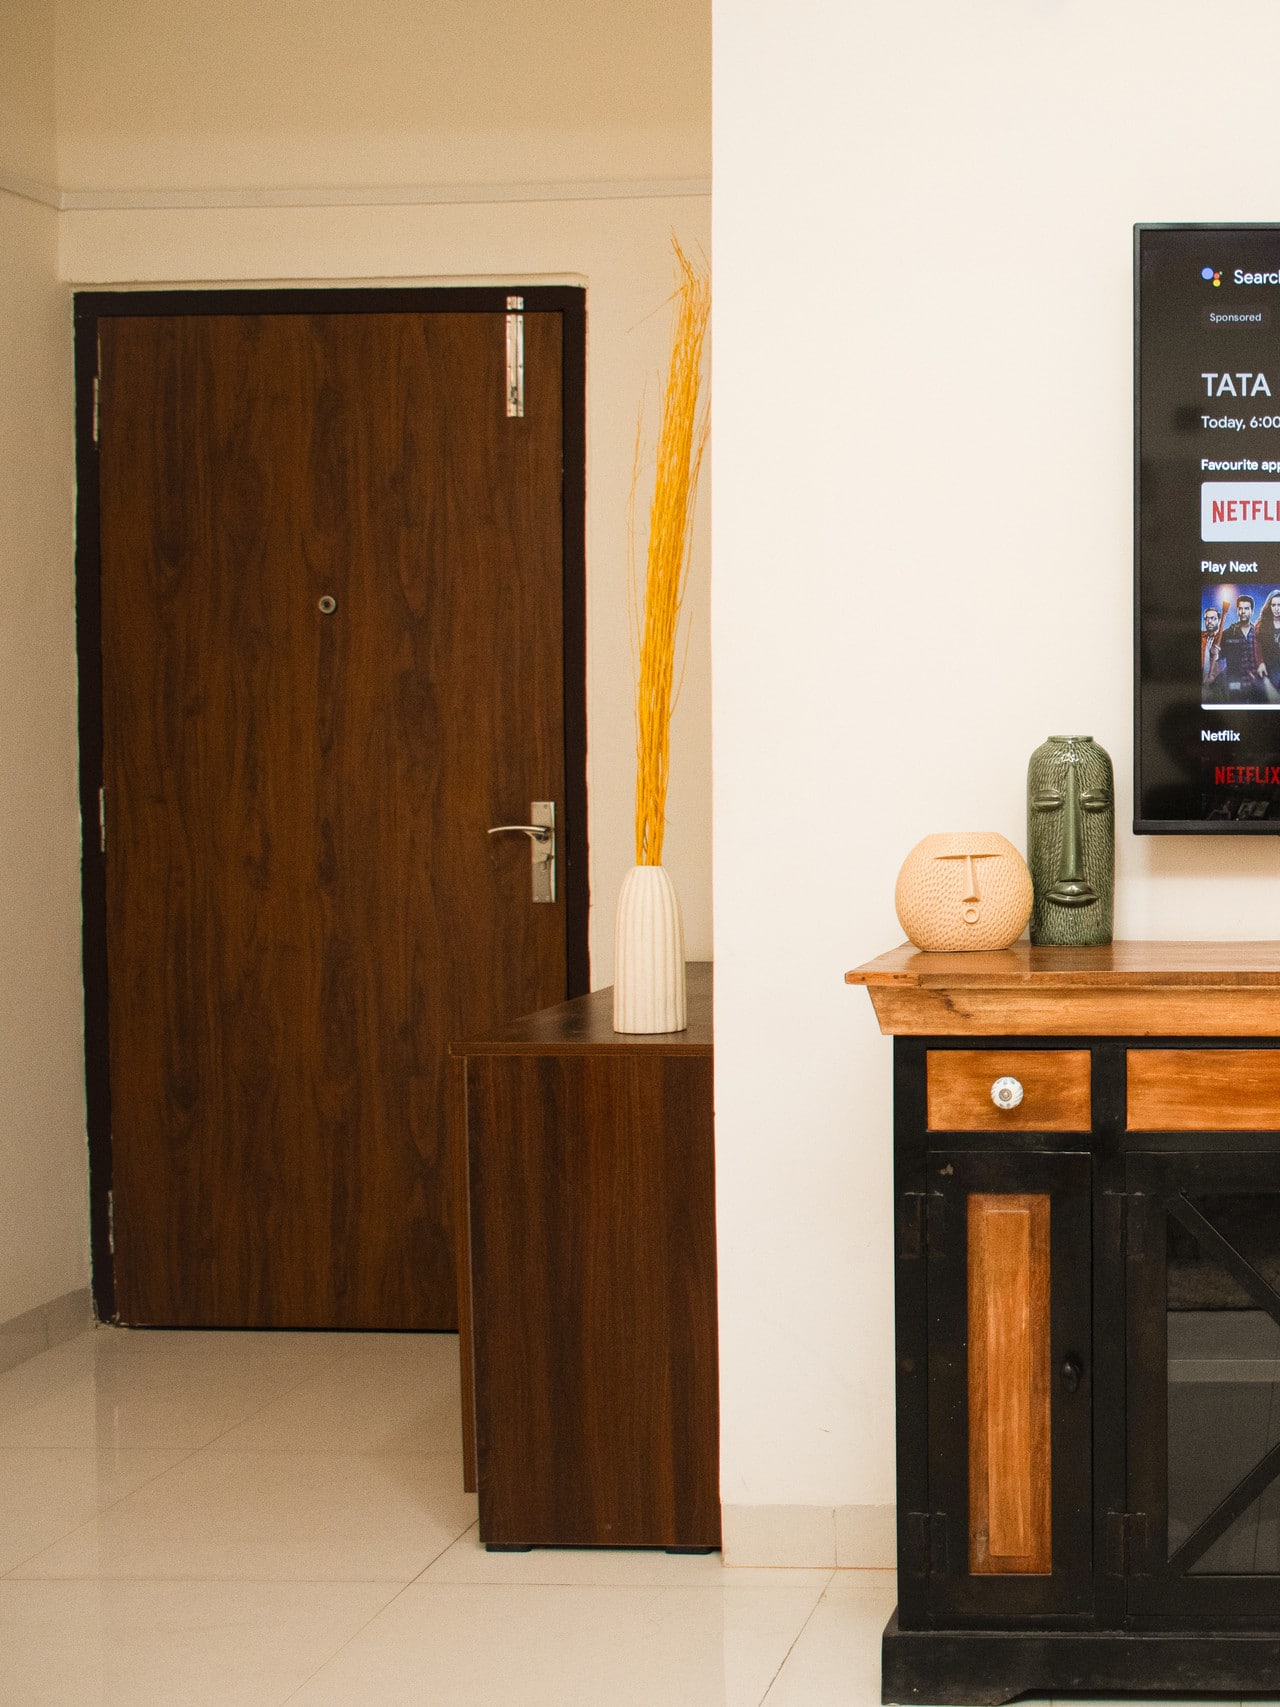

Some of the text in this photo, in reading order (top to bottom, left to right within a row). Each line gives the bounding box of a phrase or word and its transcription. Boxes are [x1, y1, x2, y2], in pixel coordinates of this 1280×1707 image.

[1209, 312, 1262, 325] Sponsored
[1201, 372, 1272, 397] TATA
[1201, 415, 1246, 432] Today,
[1201, 458, 1259, 471] Favourite
[1201, 560, 1258, 575] Play Next
[1201, 729, 1241, 742] Netflix
[1215, 766, 1280, 785] NETFLIX
